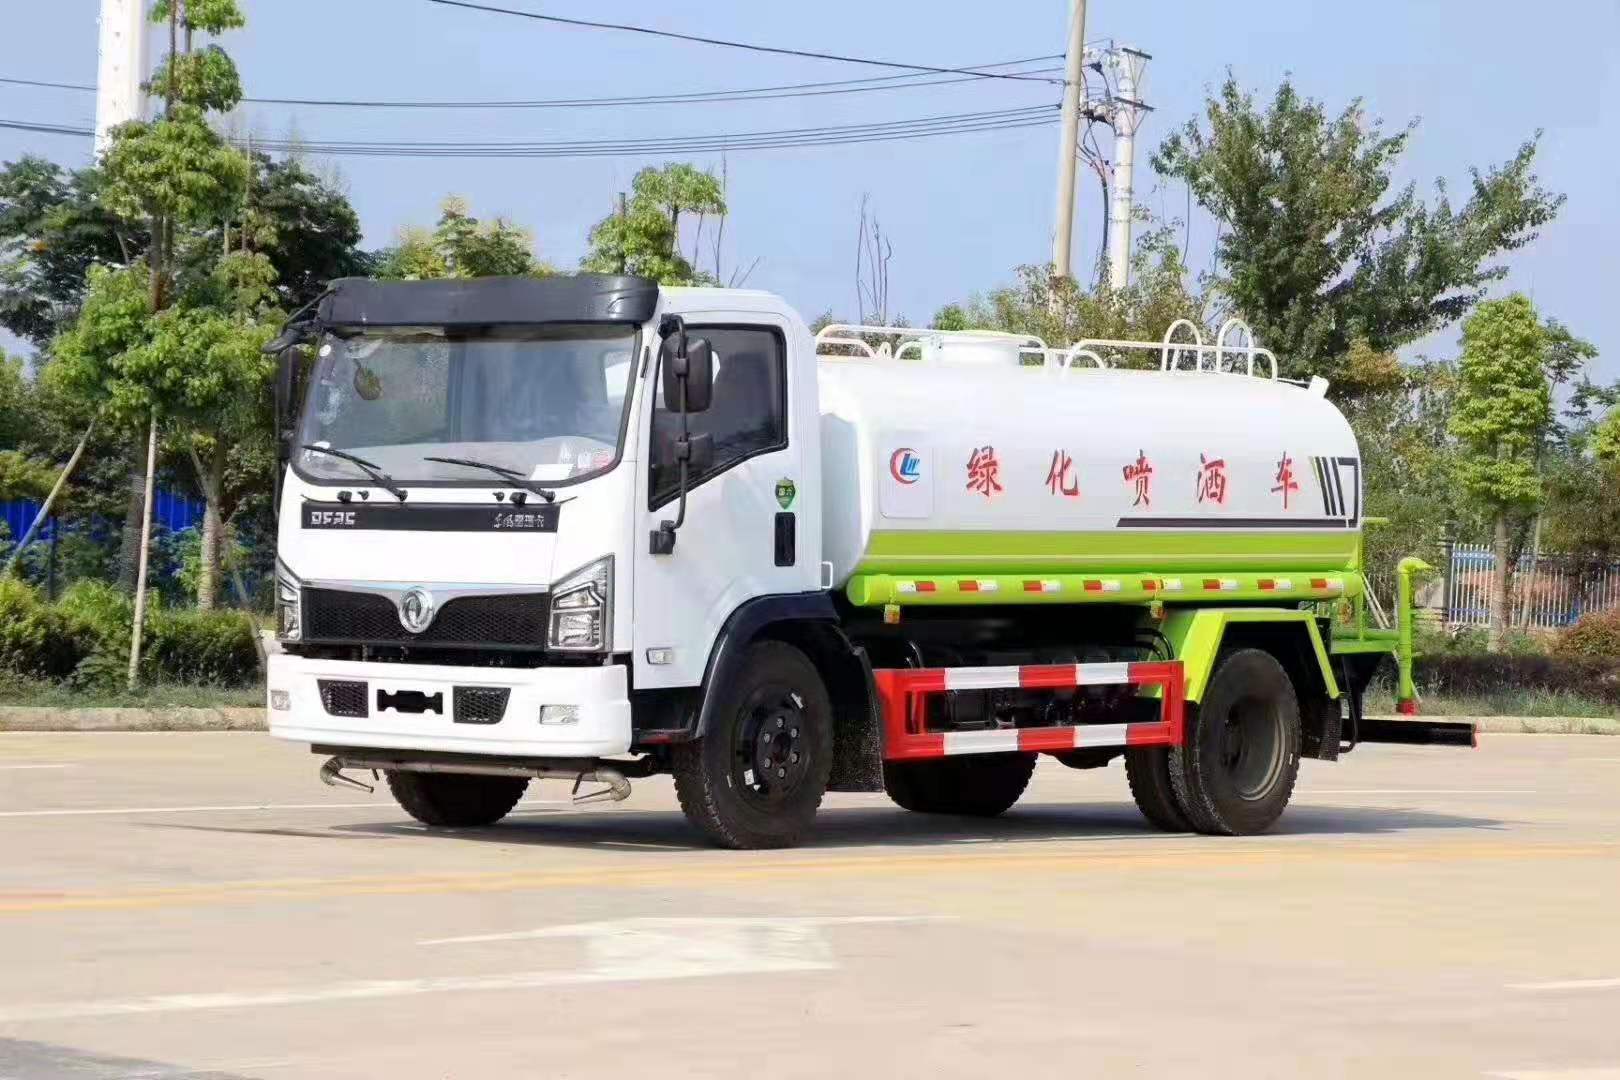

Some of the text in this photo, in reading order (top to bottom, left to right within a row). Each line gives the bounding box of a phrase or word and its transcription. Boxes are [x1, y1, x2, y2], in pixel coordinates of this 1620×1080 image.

[965, 445, 1299, 510] 绿化喷洒车
